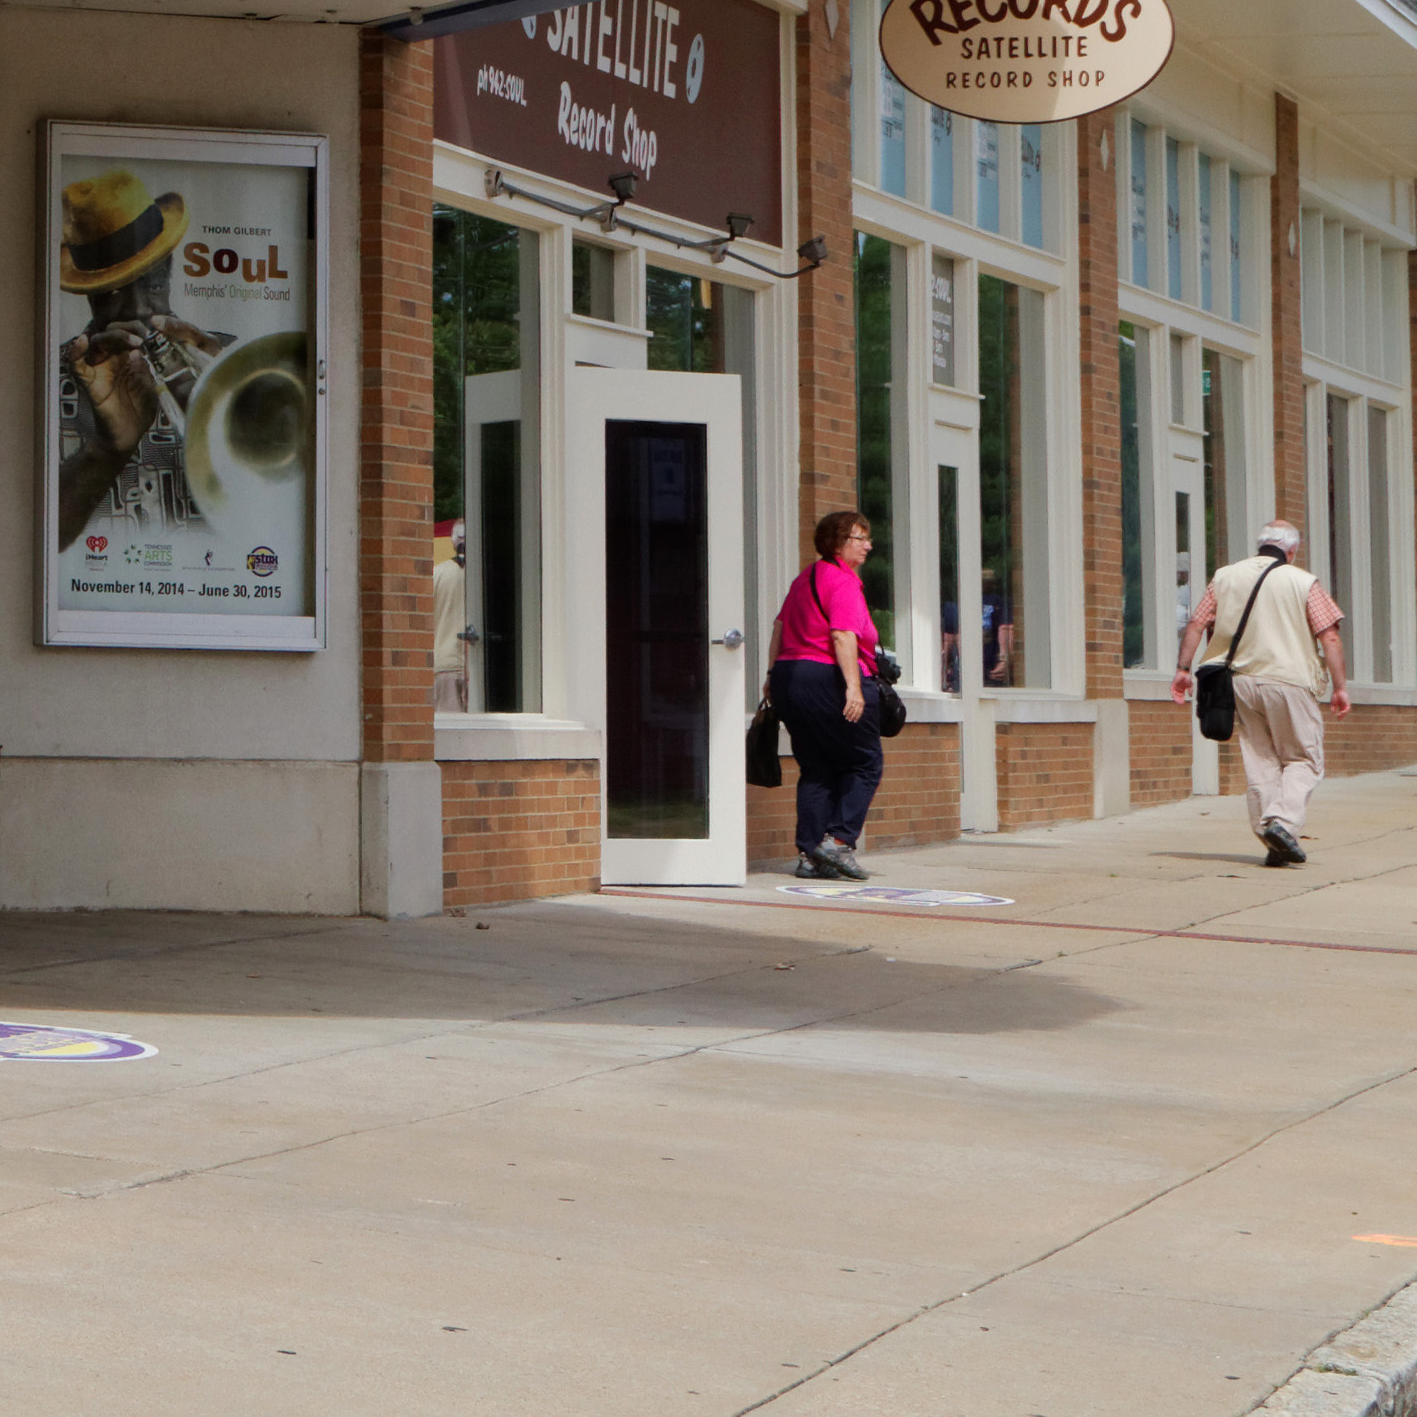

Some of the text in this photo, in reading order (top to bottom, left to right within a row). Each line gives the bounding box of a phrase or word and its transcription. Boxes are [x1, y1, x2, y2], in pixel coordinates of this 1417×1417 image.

[961, 36, 1088, 60] SATELLITE
[947, 70, 1105, 89] RECORD SHOP
[558, 81, 657, 181] Record Shop
[202, 225, 272, 237] THOM GILBERT
[229, 284, 262, 302] Original
[264, 286, 290, 301] Sound
[144, 551, 173, 561] ARTS
[71, 579, 135, 594] November
[139, 582, 154, 596] 14,
[158, 582, 185, 595] 2014
[198, 584, 229, 597] June
[233, 585, 250, 598] 30,
[254, 585, 281, 598] 2015
